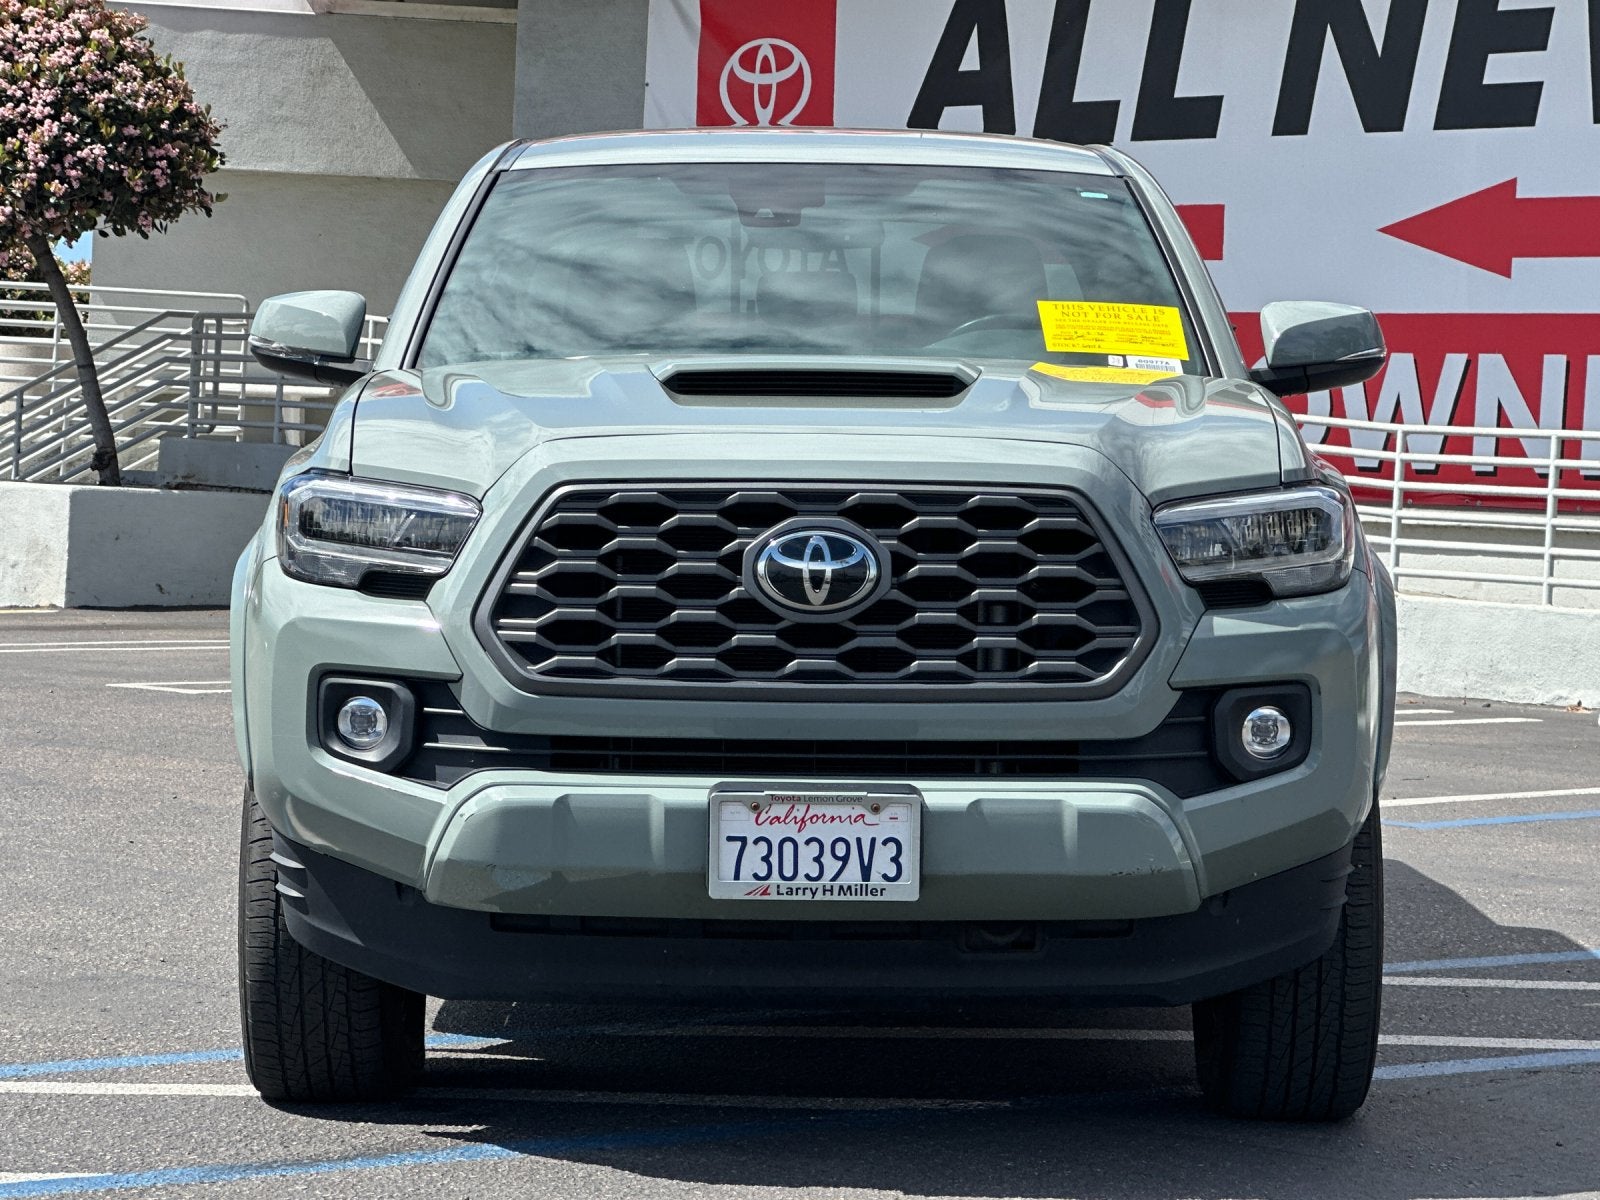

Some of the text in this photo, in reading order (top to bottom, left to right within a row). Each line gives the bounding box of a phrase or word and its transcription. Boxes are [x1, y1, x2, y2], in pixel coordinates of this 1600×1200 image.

[906, 0, 1600, 144] ALL NE
[1052, 303, 1166, 316] THIS VEHICLE IS
[1061, 310, 1161, 322] NOT FOR SALE
[770, 794, 863, 804] Toyota Lemon Grove
[754, 803, 880, 833] California
[725, 835, 903, 883] 73039V3
[776, 884, 887, 899] Larry H Miller
